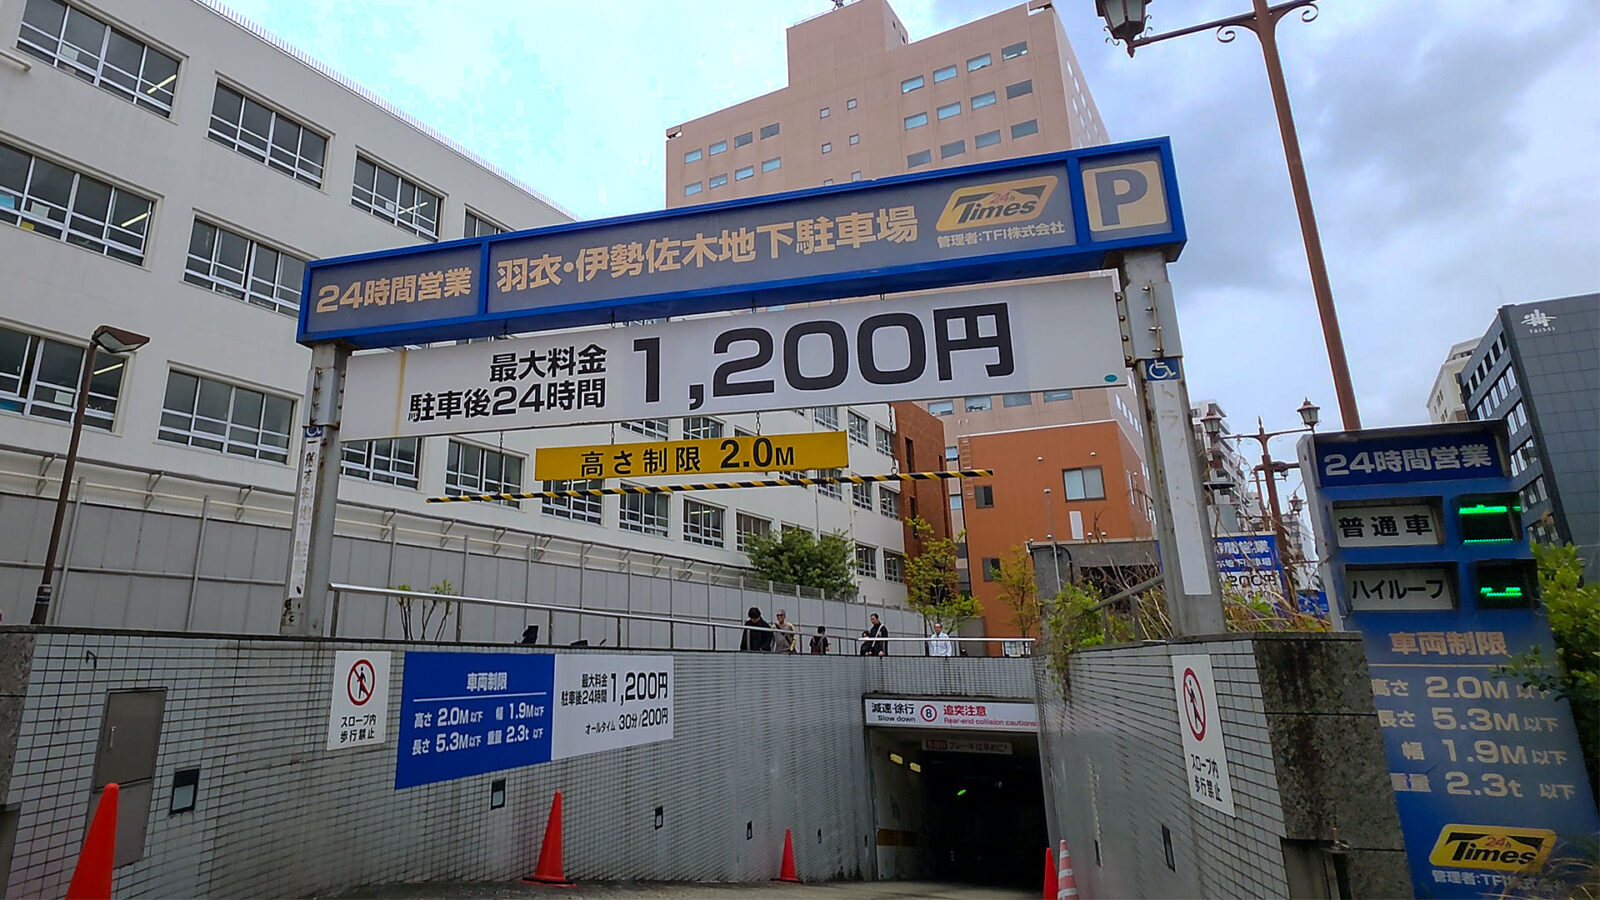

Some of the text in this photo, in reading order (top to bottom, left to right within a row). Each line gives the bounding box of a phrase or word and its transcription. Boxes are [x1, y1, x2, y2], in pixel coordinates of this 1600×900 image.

[1094, 168, 1149, 227] P
[955, 199, 1038, 226] Times
[496, 205, 919, 293] 羽衣・伊勢佐木地下駐車場
[315, 267, 473, 314] 24時間営業
[489, 343, 607, 382] 最大料金
[633, 302, 1016, 411] 1,200円
[407, 378, 607, 423] 駐車後24時間
[580, 437, 795, 479] 高さ制限 2.0M
[1324, 443, 1493, 477] 24時間営業
[1338, 513, 1434, 539] 普通車
[1351, 578, 1444, 601] ハイルーフ
[1389, 631, 1509, 657] 車両制限
[466, 672, 508, 692] 車両制限
[581, 673, 609, 688] 最大料金
[610, 671, 669, 706] 1,200円
[1370, 678, 1410, 698] 高さ
[1424, 676, 1509, 700] 2.0M
[560, 689, 608, 707] 駐車後24時間
[943, 704, 988, 717] 追突注意
[340, 713, 377, 729] スロープ内
[414, 712, 433, 729] 高さ
[585, 720, 616, 735] オールタイム
[877, 715, 916, 723] Slow down
[976, 718, 1005, 726] collision
[1378, 707, 1559, 732] 長さ 5.3M 以下
[340, 727, 376, 744] 歩行禁止
[412, 738, 431, 756] 長さ
[1441, 739, 1529, 765] 1.9M
[1532, 750, 1568, 766] 以下
[1190, 753, 1220, 779] スロープ内
[1194, 774, 1223, 803] 歩行禁止
[1445, 771, 1524, 798] 2.3t
[1539, 783, 1576, 800] 以下
[1451, 840, 1538, 866] Times
